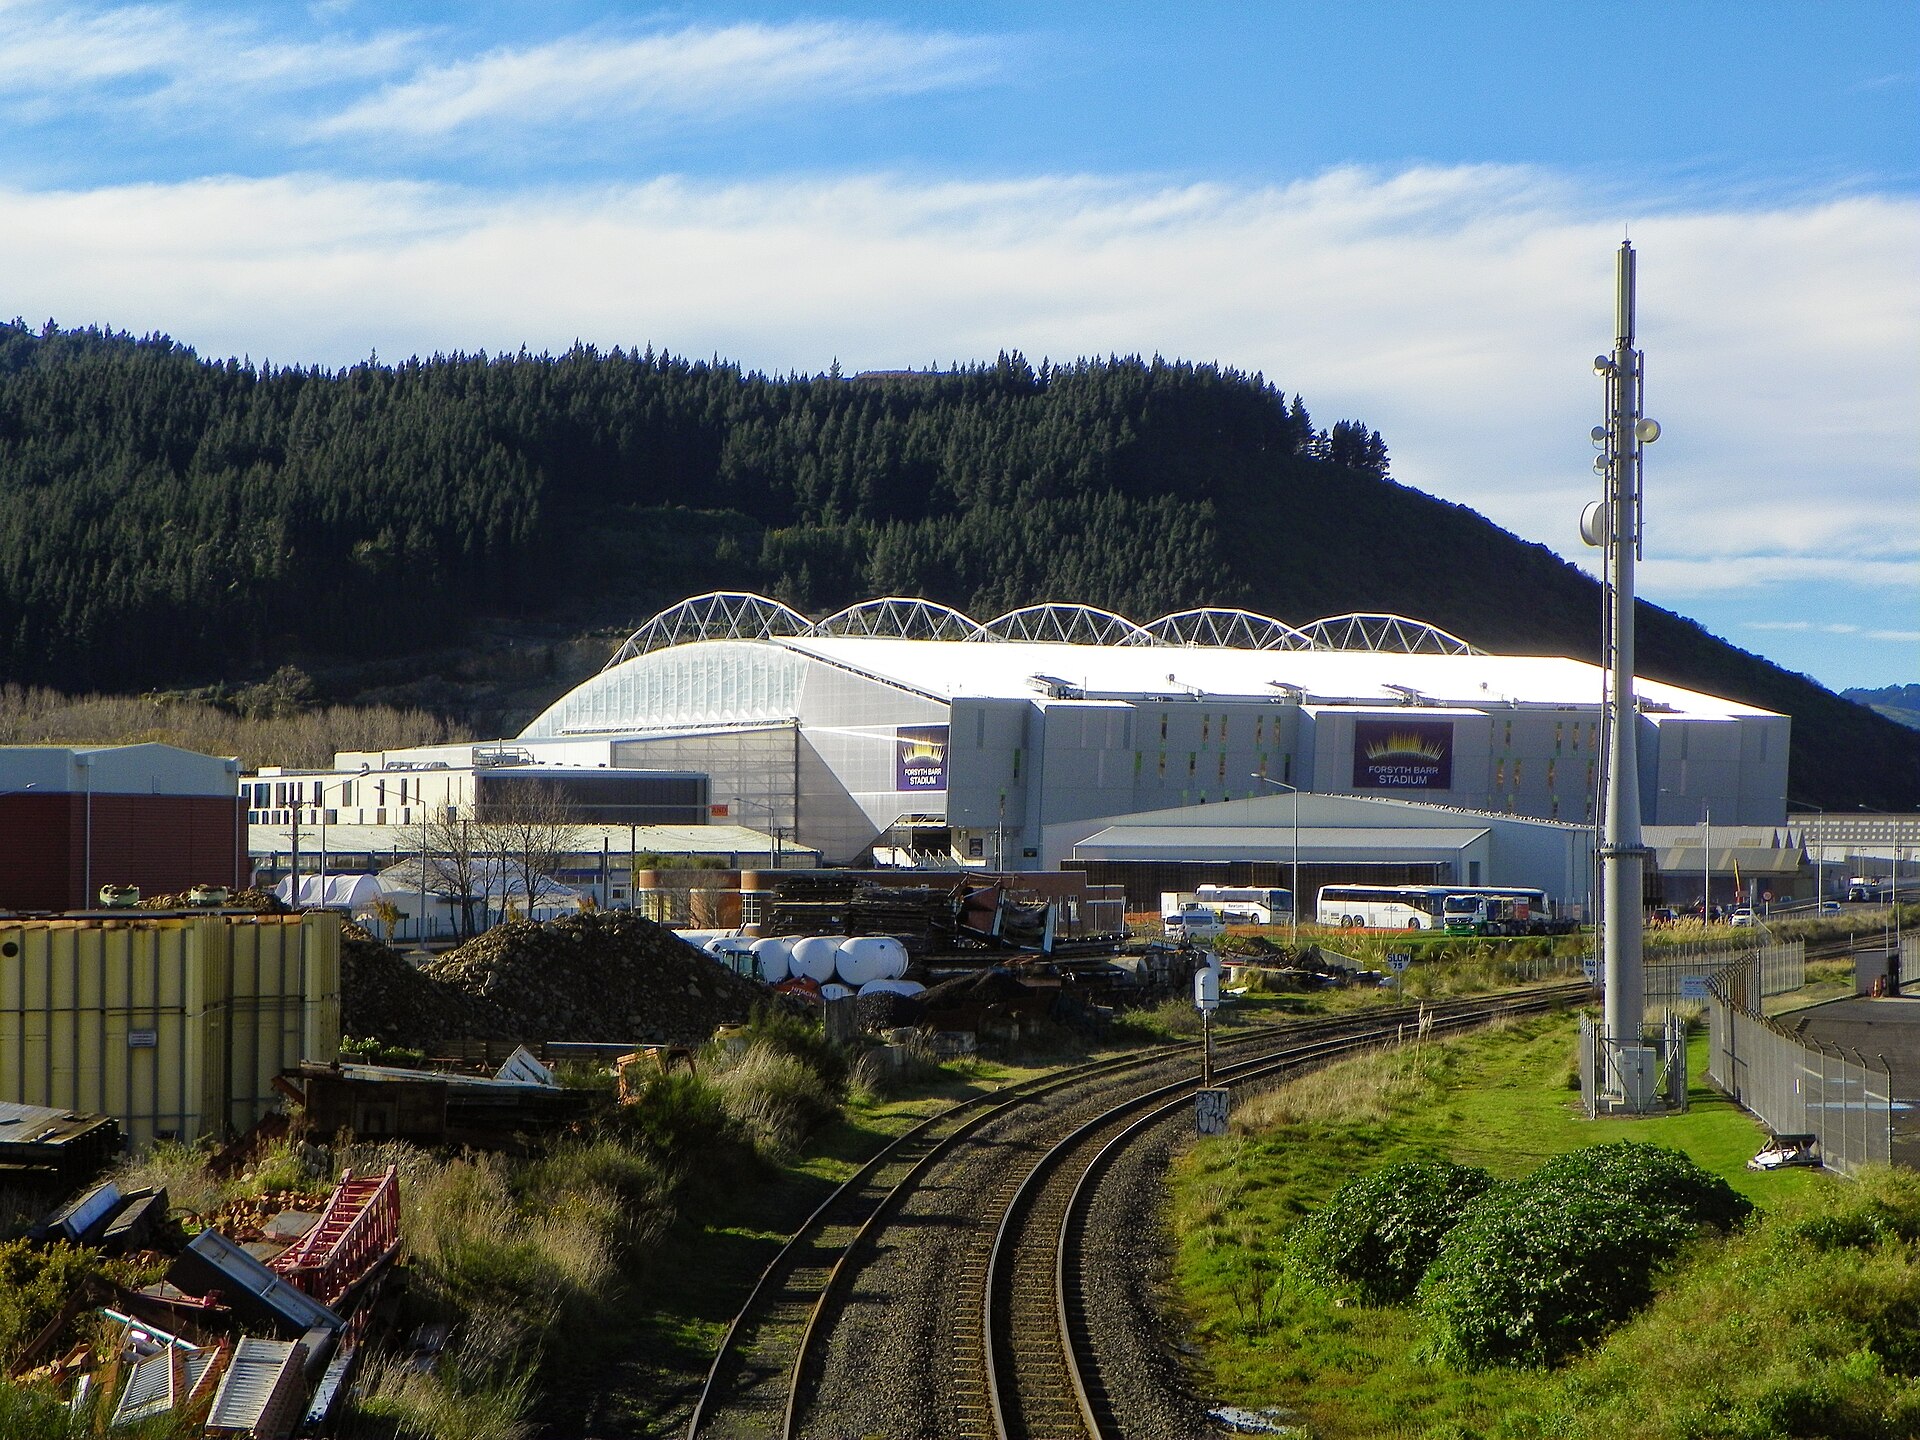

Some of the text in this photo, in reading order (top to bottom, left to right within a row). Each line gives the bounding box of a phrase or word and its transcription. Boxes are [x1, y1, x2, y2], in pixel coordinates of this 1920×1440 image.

[904, 768, 942, 776] FORSYTH BARR
[1368, 765, 1439, 775] FORSYTH BARR
[909, 776, 936, 785] STADIUM
[1379, 774, 1428, 785] STADIUM
[1387, 953, 1410, 962] SLOW
[791, 986, 818, 999] HITACHI
